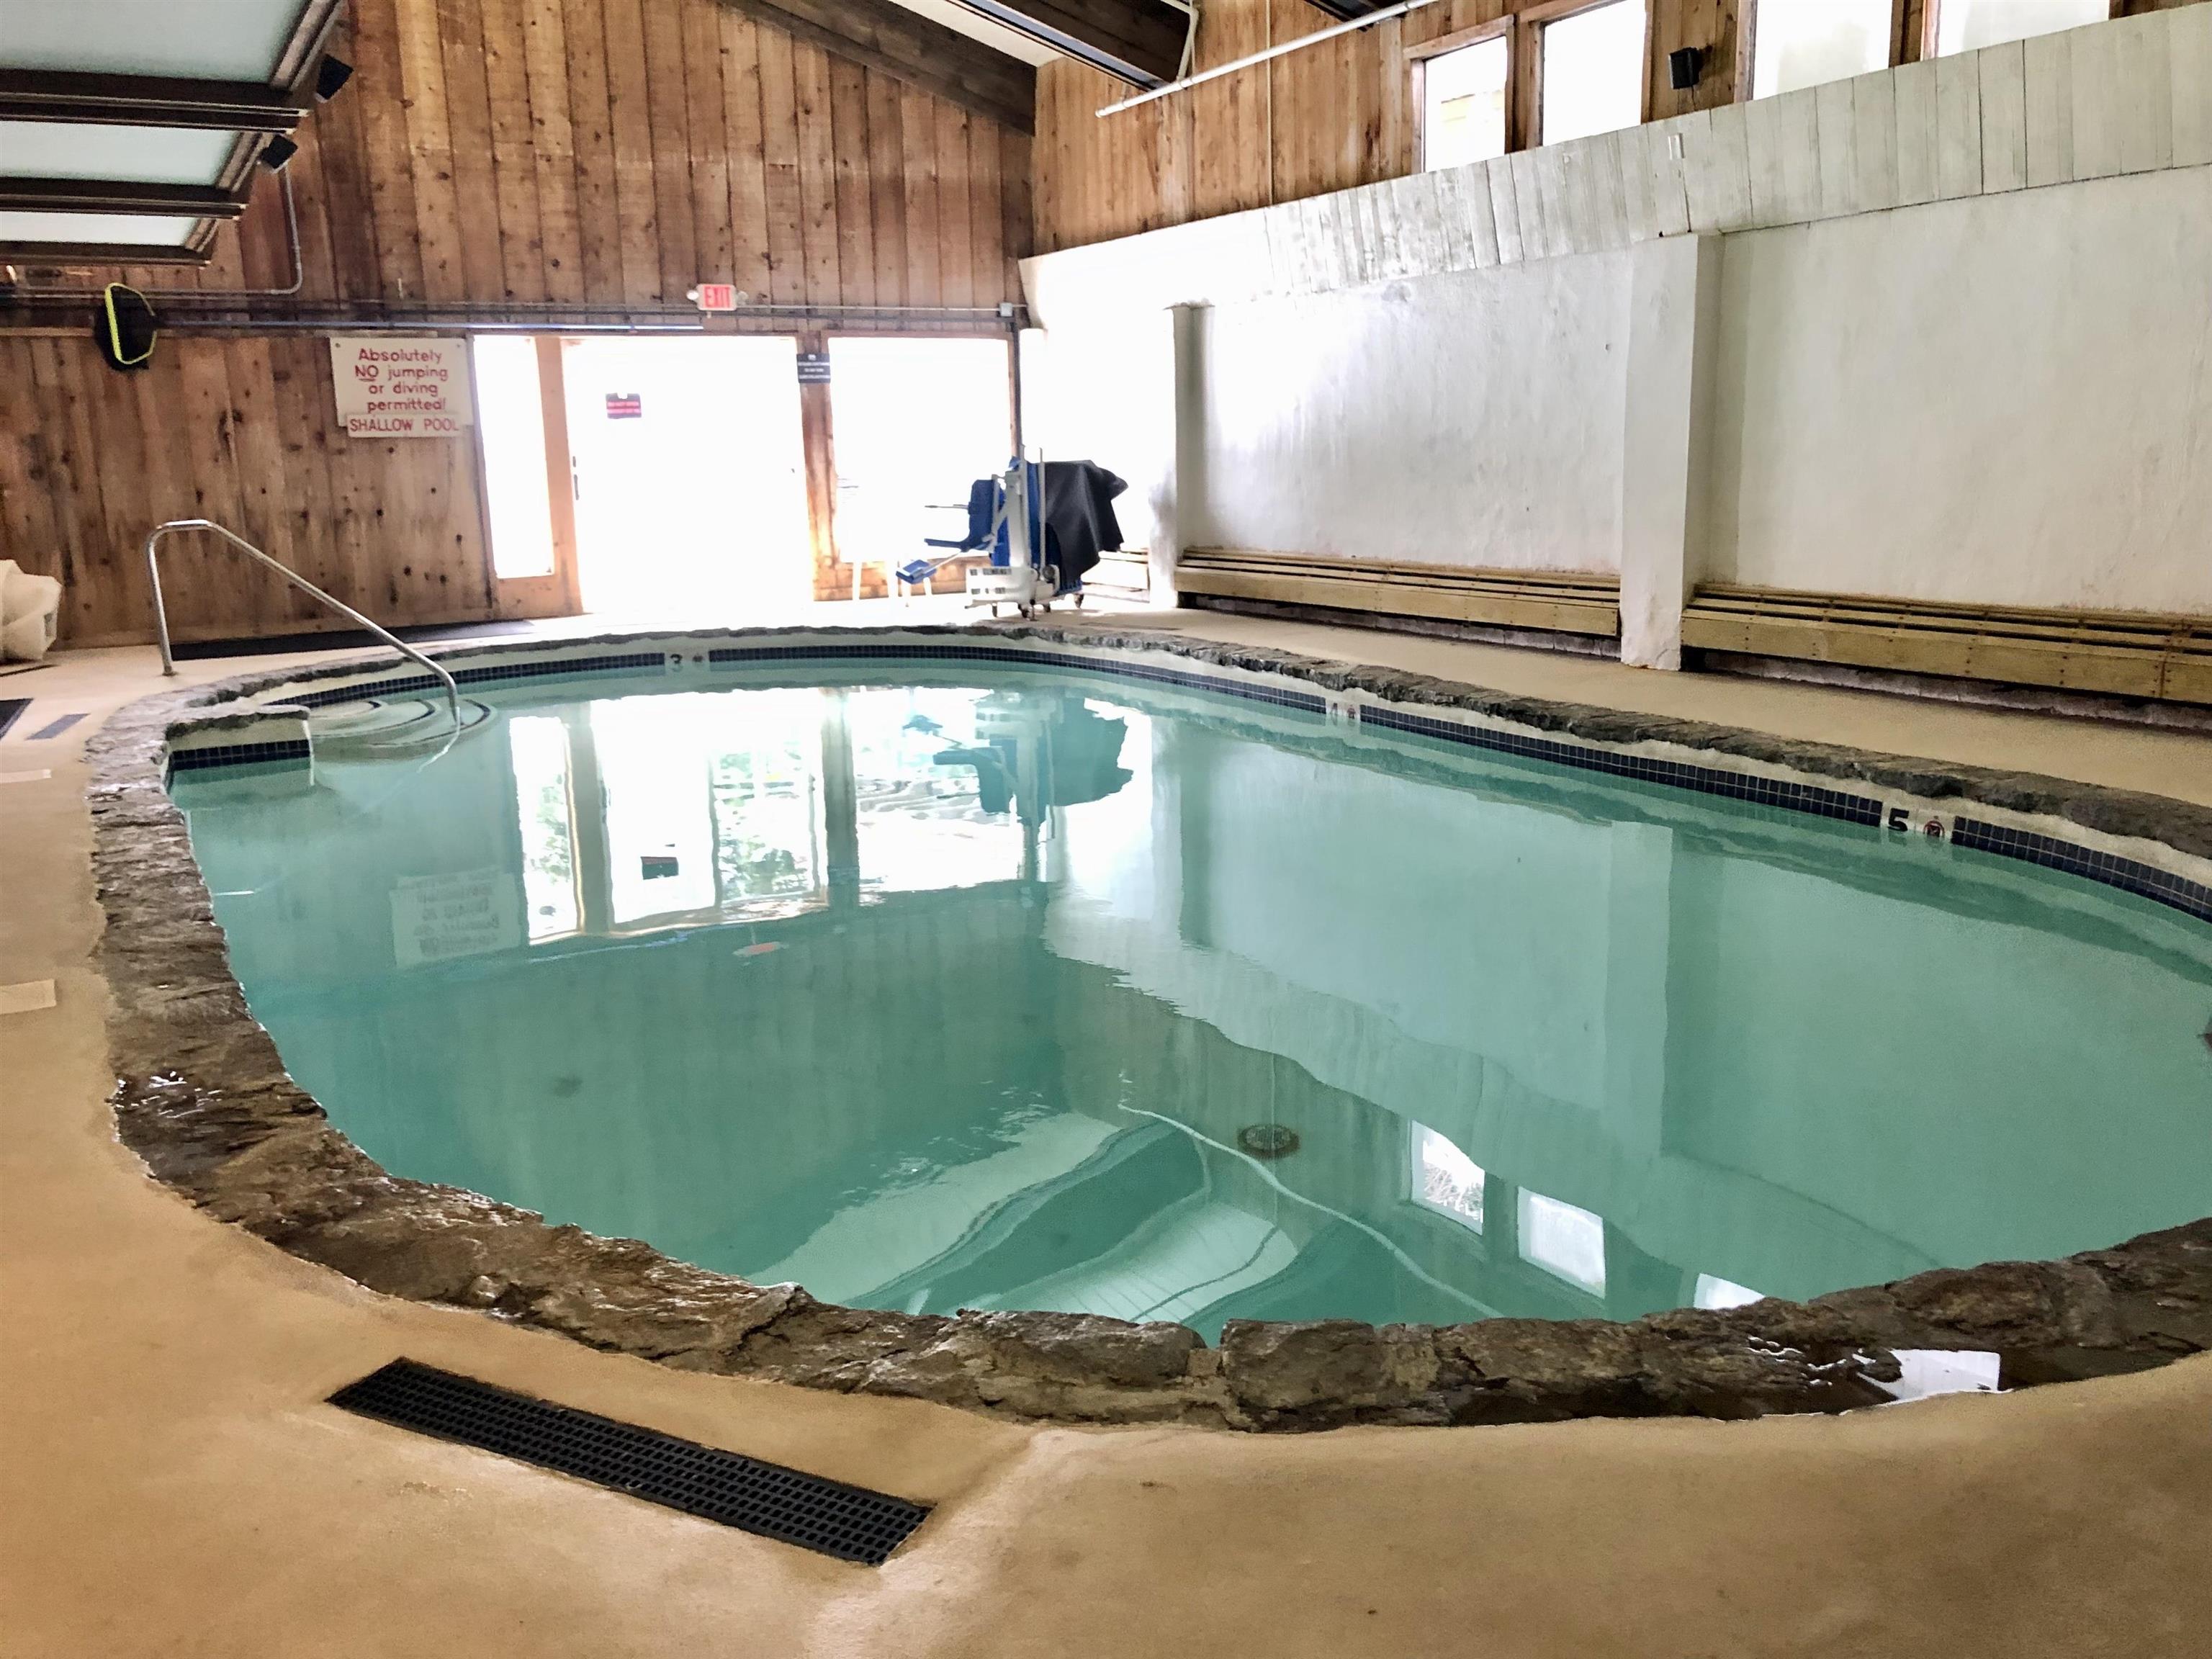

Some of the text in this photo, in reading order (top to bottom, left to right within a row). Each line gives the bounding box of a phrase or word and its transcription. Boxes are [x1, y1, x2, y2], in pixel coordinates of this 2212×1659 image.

[704, 287, 730, 308] EXIT
[359, 348, 443, 364] Absolutely
[355, 365, 448, 382] NO jumping
[369, 382, 438, 397] or diving
[367, 397, 446, 413] permitted!
[350, 418, 459, 431] SHALLOW POOL
[1888, 808, 1910, 832] 5
